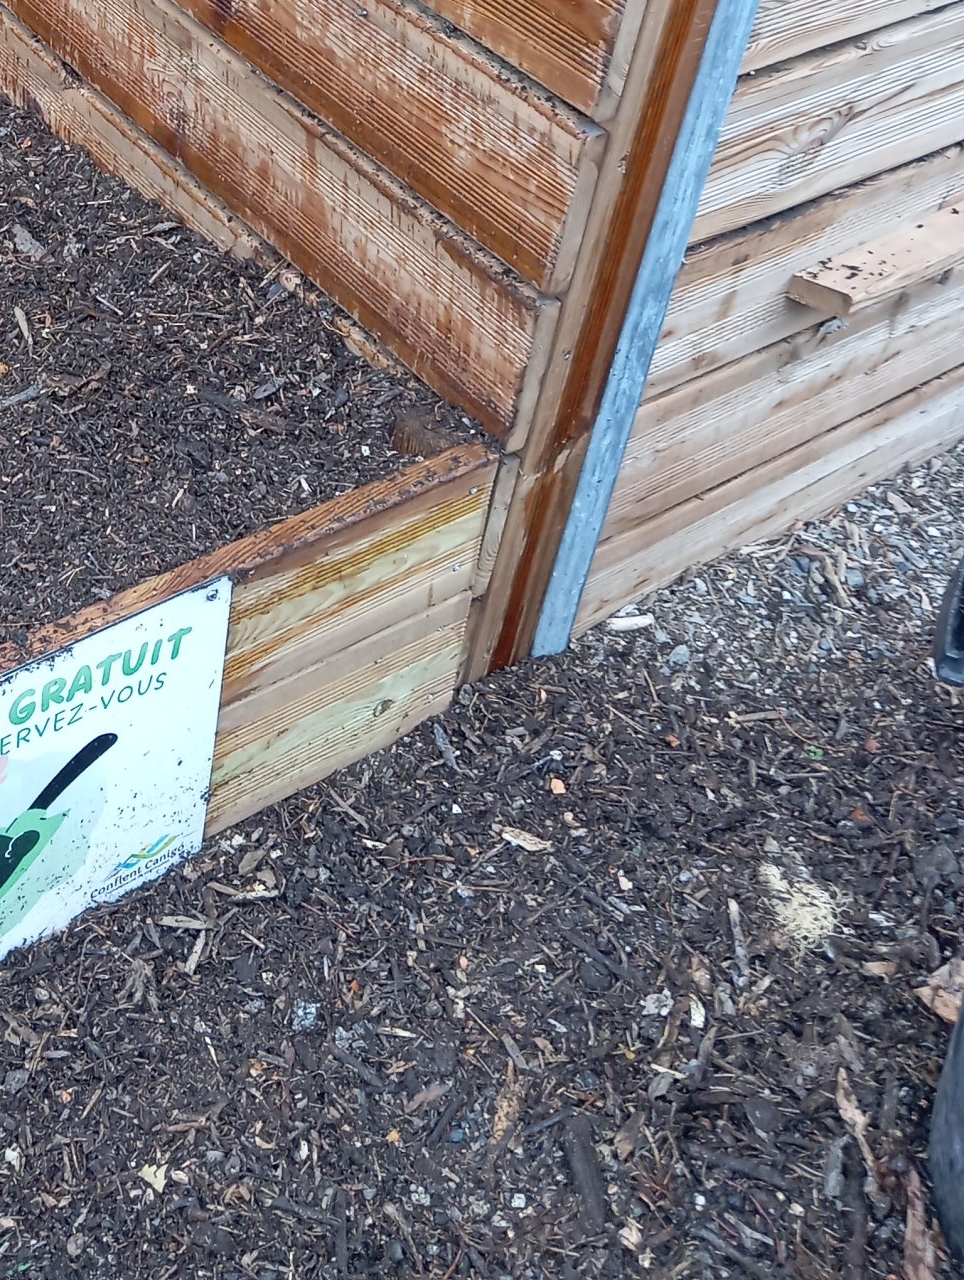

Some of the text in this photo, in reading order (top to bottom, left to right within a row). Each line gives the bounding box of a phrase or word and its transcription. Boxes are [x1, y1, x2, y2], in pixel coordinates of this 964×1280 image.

[9, 626, 192, 726] GRATUIT
[90, 865, 142, 899] Conflent
[144, 841, 185, 869] Canigó
